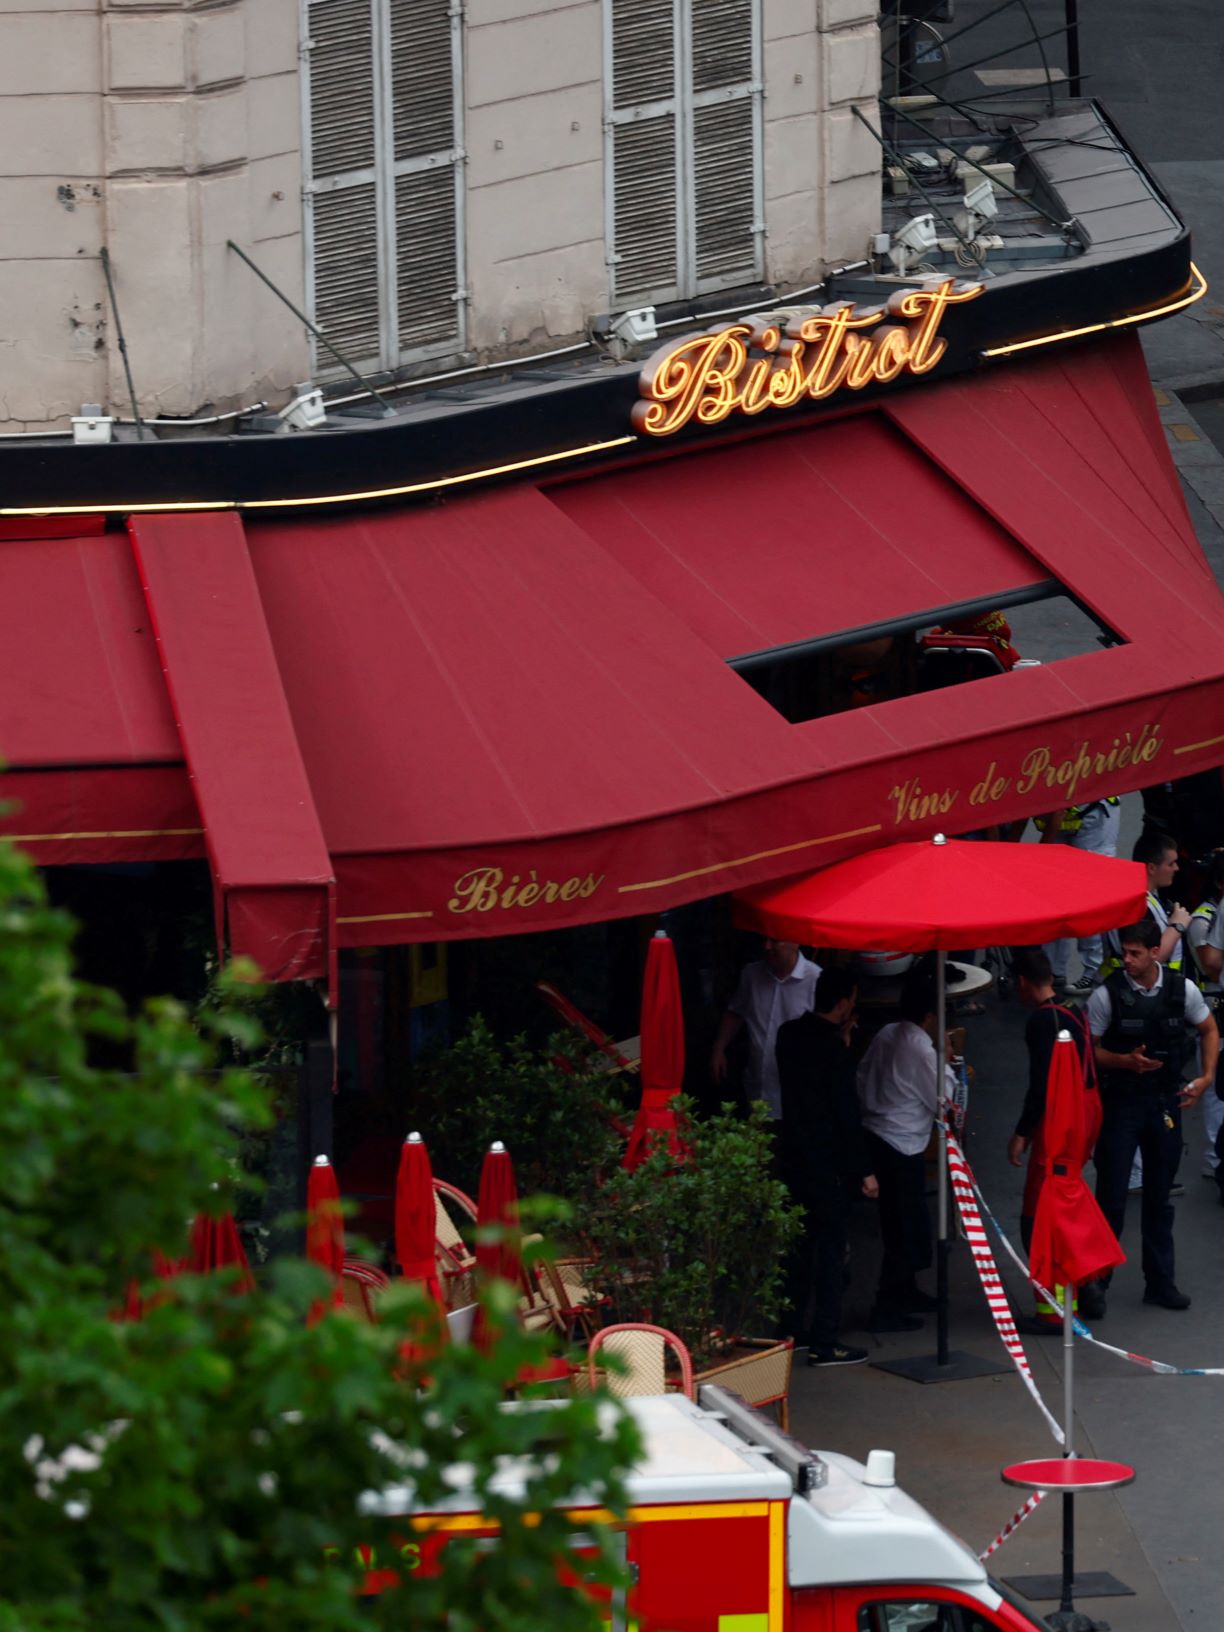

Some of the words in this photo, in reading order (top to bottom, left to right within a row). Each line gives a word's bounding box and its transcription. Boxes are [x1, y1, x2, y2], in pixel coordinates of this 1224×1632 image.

[637, 277, 986, 436] Bistrot
[888, 778, 959, 824] Vins
[969, 762, 1011, 806] de
[448, 867, 606, 913] Bières
